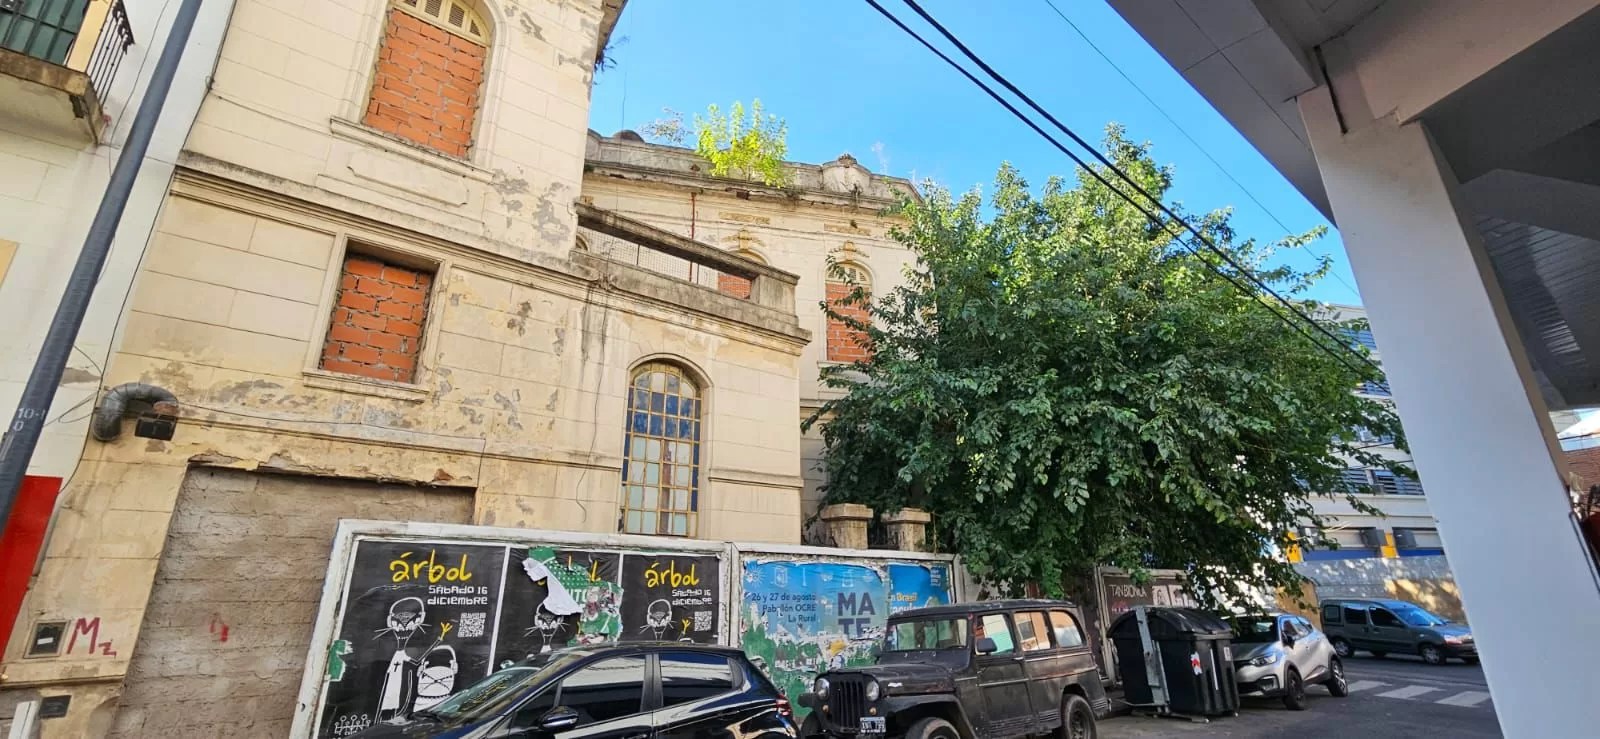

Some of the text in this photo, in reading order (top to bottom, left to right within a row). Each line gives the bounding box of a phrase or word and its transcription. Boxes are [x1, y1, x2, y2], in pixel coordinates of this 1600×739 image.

[389, 548, 472, 584] árbol
[644, 559, 700, 588] árbol
[477, 586, 488, 596] 16
[769, 592, 779, 601] 27
[781, 592, 790, 601] de
[792, 592, 817, 603] agosto
[795, 604, 816, 612] OCRE
[837, 591, 876, 617] MA
[788, 614, 816, 623] La Rural
